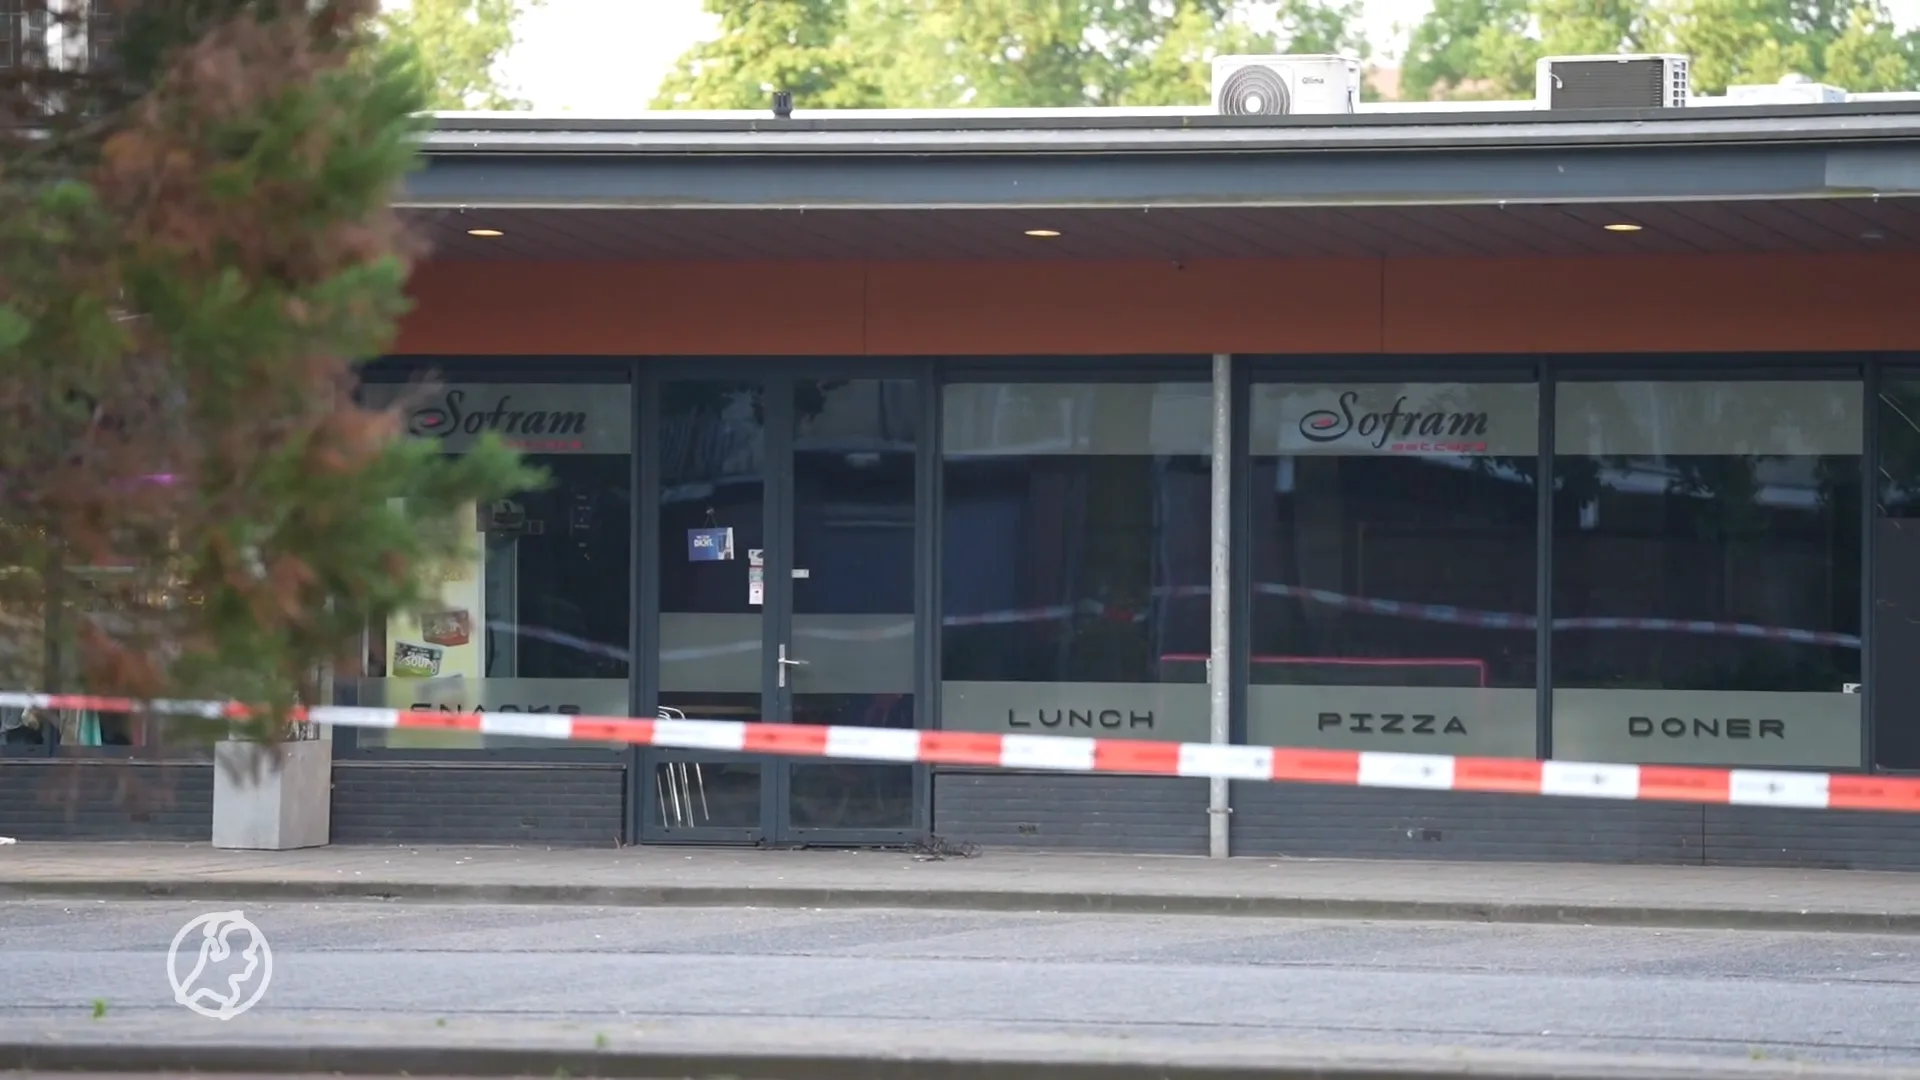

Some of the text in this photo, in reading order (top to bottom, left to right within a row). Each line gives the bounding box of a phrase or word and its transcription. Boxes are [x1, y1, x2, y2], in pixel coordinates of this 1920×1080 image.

[409, 390, 587, 438] Sofram
[1299, 391, 1488, 449] Sofram
[1008, 708, 1154, 729] LUNCH
[1317, 712, 1467, 735] PIZZA
[1628, 716, 1785, 739] DONER
